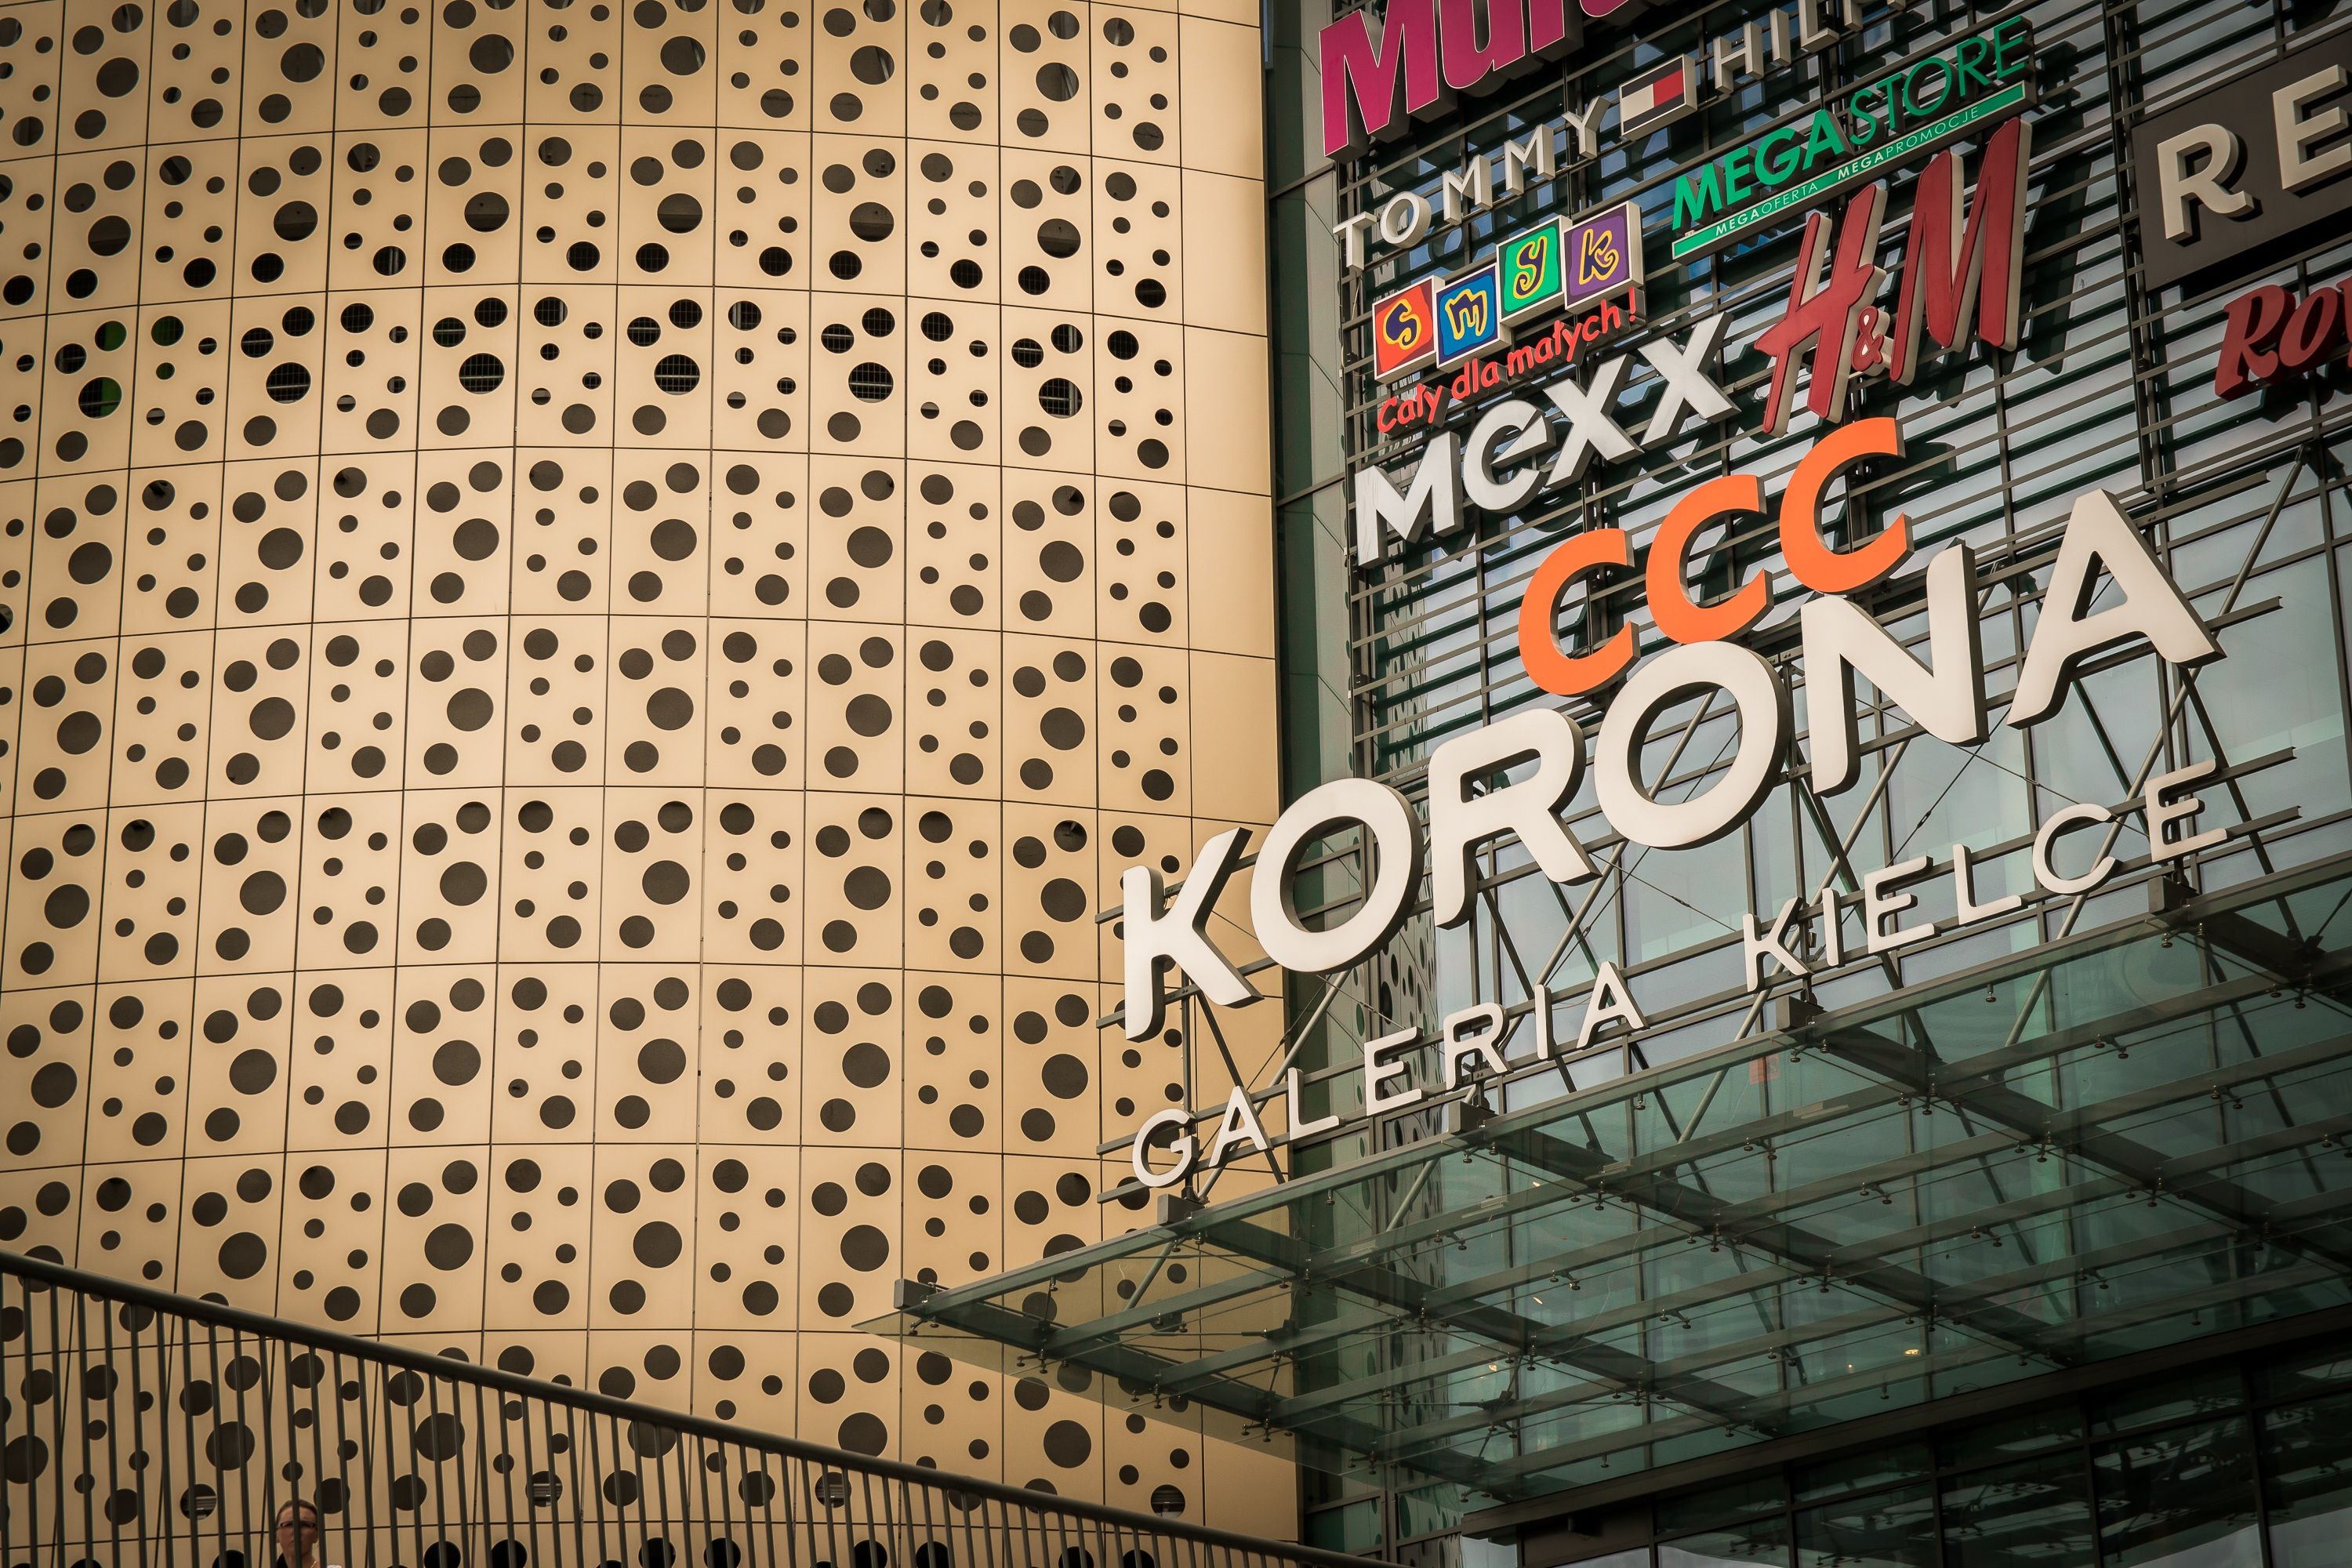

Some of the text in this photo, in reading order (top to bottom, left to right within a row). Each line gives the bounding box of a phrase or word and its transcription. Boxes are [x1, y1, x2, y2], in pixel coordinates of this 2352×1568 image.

[1319, 0, 1631, 157] Mu
[1333, 0, 1906, 271] TOMMY HIL
[1671, 15, 2027, 230] MEGASTORE
[1715, 107, 1979, 236] MEGAOFERTA MEGAPROMOCJE
[2158, 64, 2352, 239] RE
[1377, 385, 1443, 434] Cały
[1451, 358, 1500, 400] dla
[1754, 117, 2032, 437] H&M
[1519, 418, 1914, 696] CCC
[1123, 489, 2226, 1042] KORONA
[1132, 757, 2230, 1187] GALERIA KIELCE
